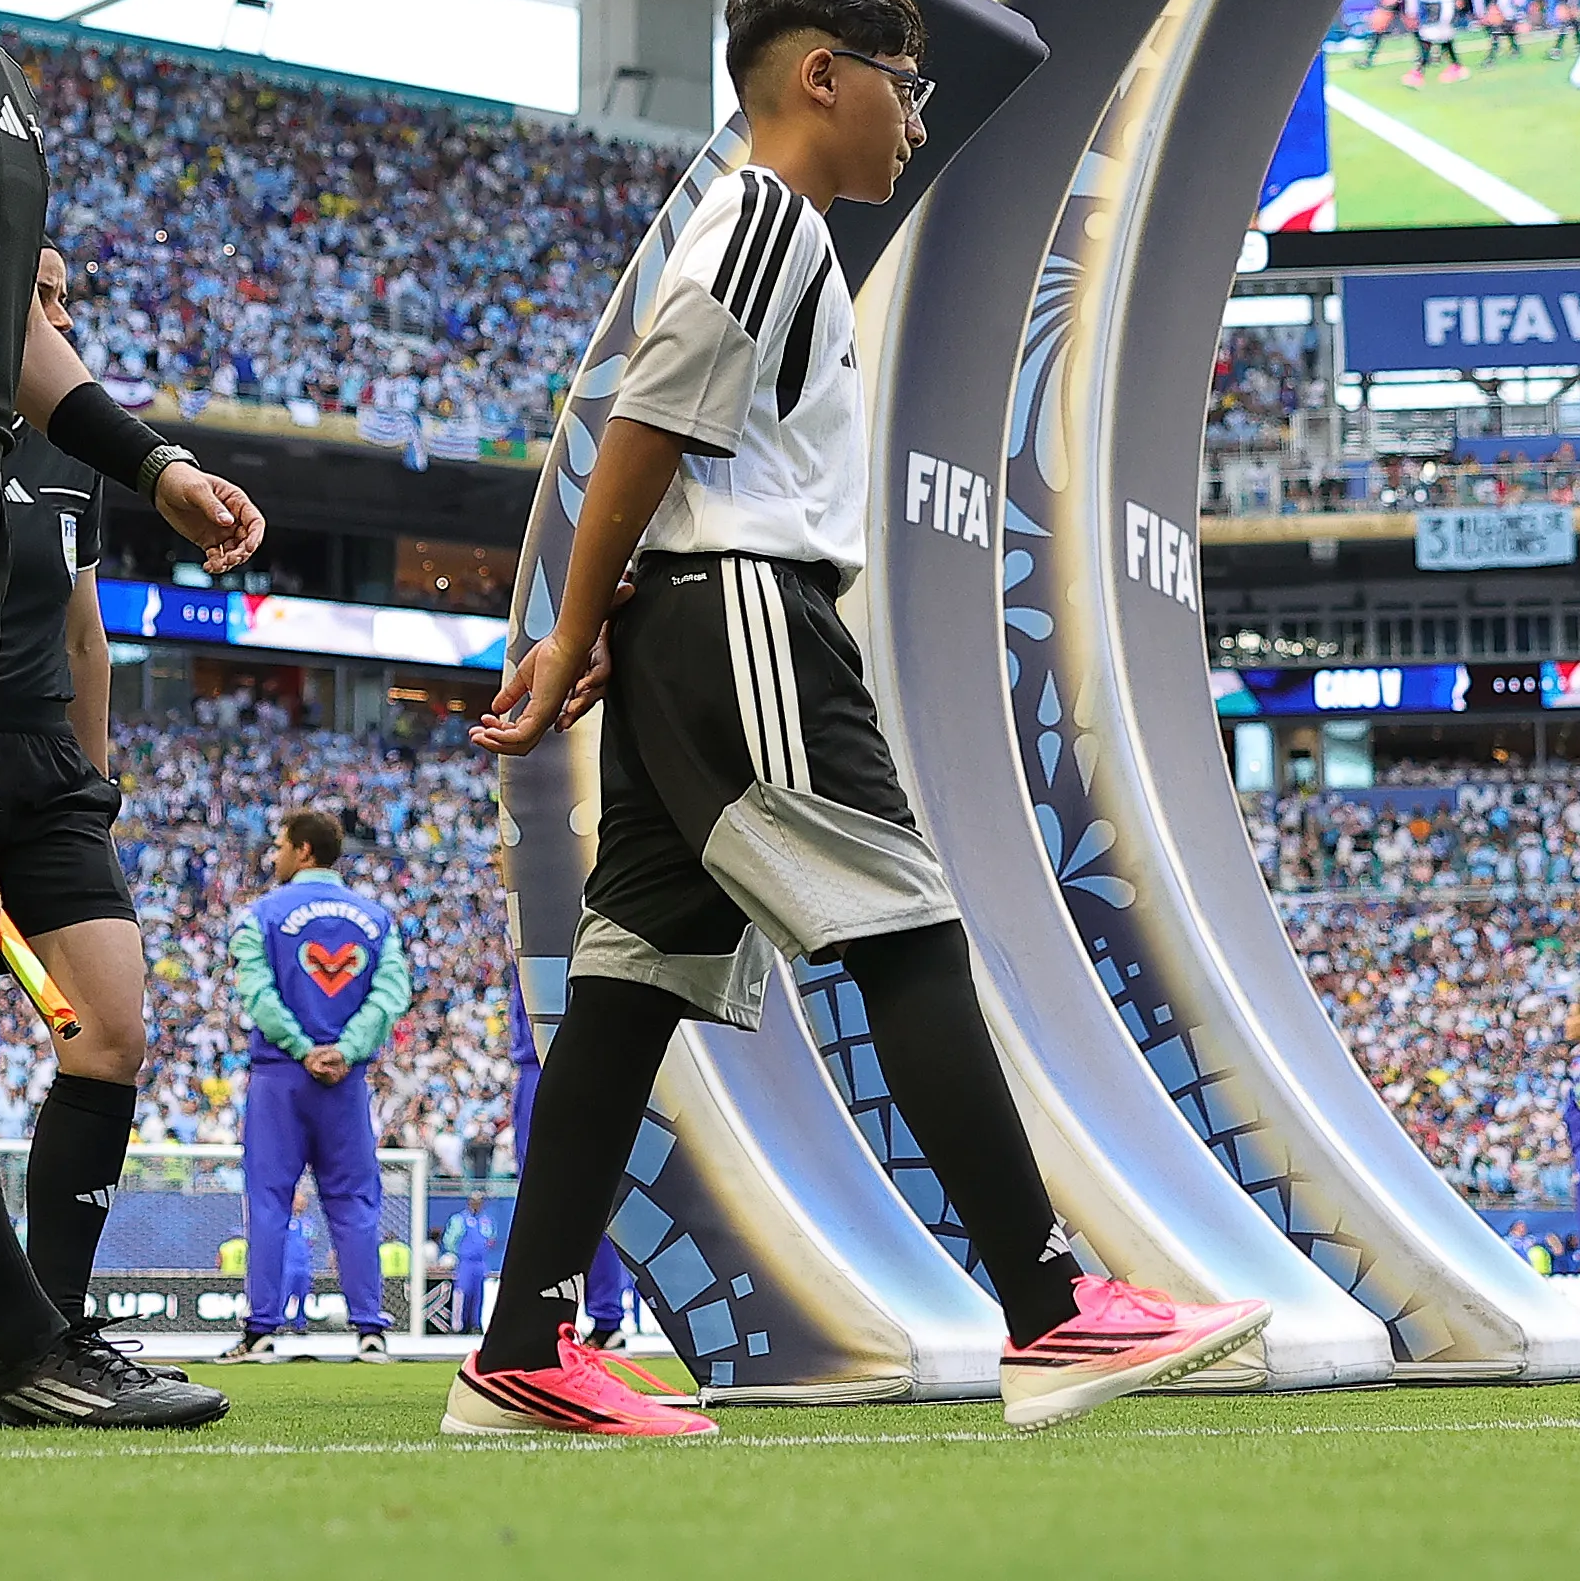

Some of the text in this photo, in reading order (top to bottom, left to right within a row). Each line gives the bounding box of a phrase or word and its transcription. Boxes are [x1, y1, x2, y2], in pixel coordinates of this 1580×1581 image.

[1423, 293, 1558, 347] FIFA
[906, 451, 990, 549] FIFA
[1126, 500, 1197, 613] FIFA
